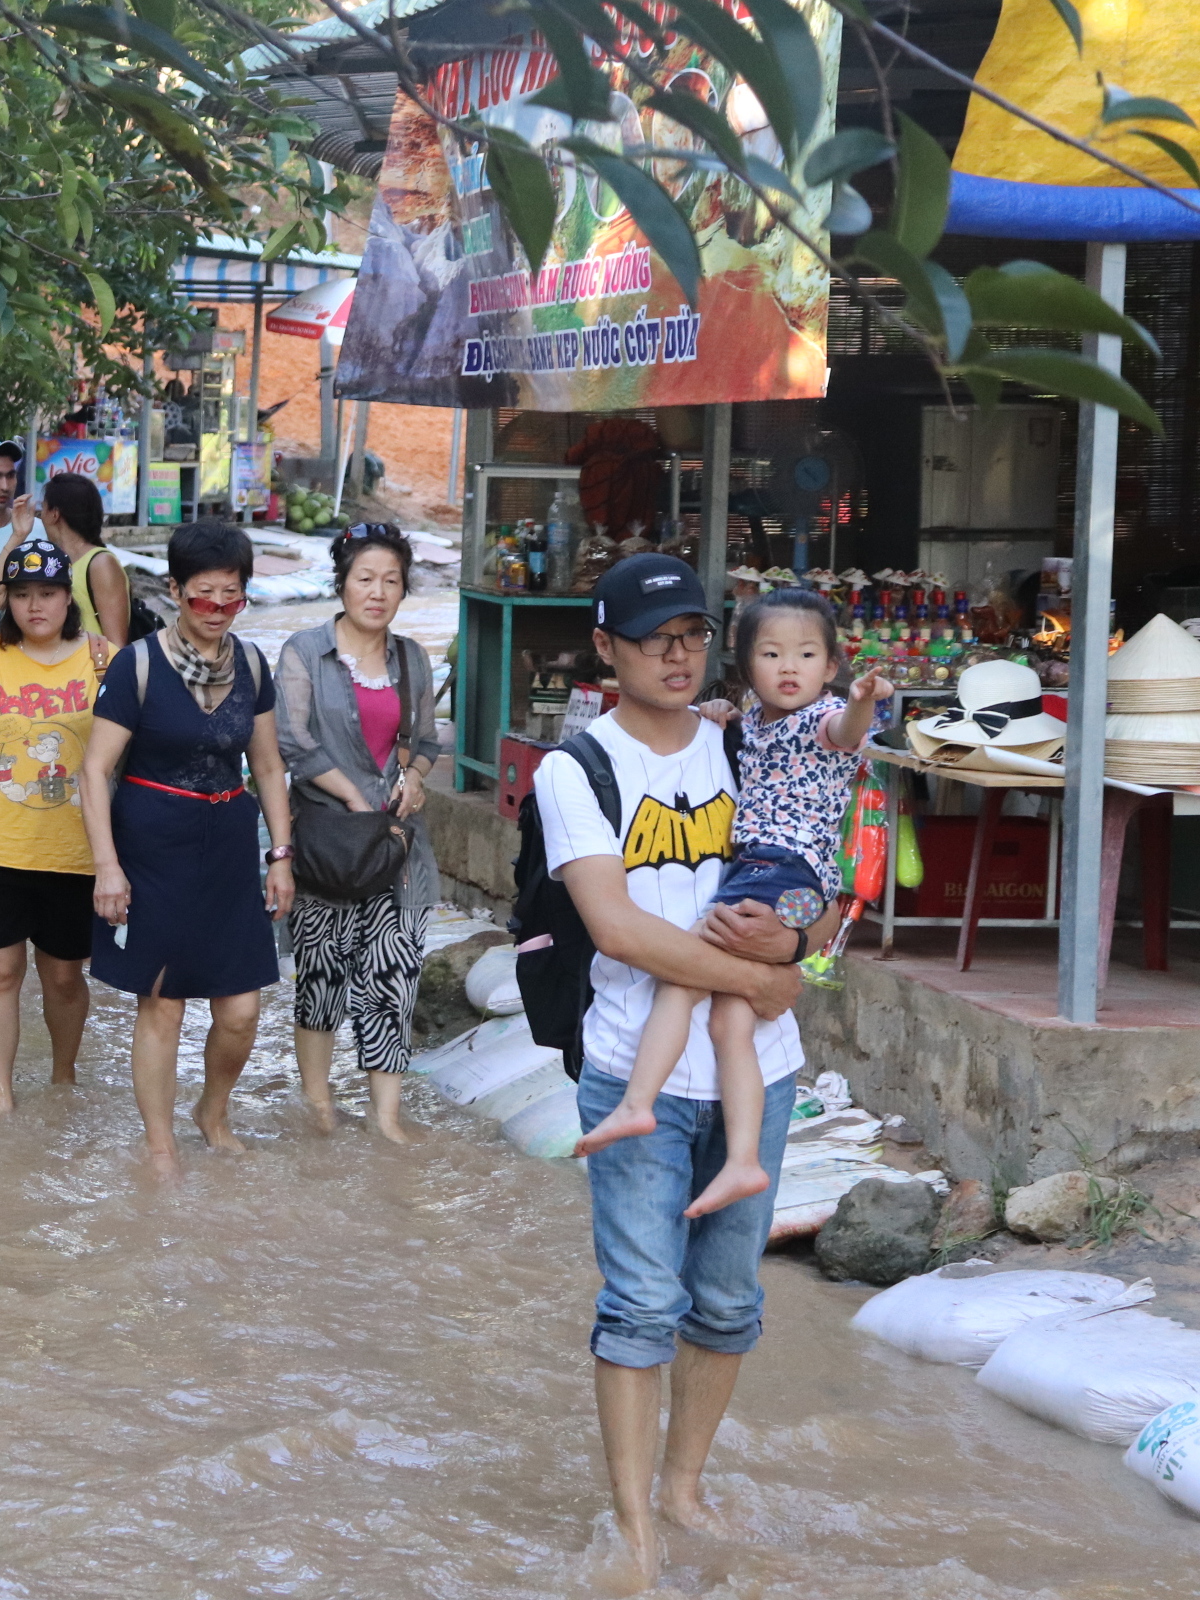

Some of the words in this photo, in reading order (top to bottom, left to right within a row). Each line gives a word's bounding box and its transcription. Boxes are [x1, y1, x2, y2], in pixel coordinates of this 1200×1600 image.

[559, 243, 603, 305] RUỐC
[623, 304, 661, 366] CỐT
[663, 303, 701, 363] DỪA
[623, 790, 737, 869] BATMAN
